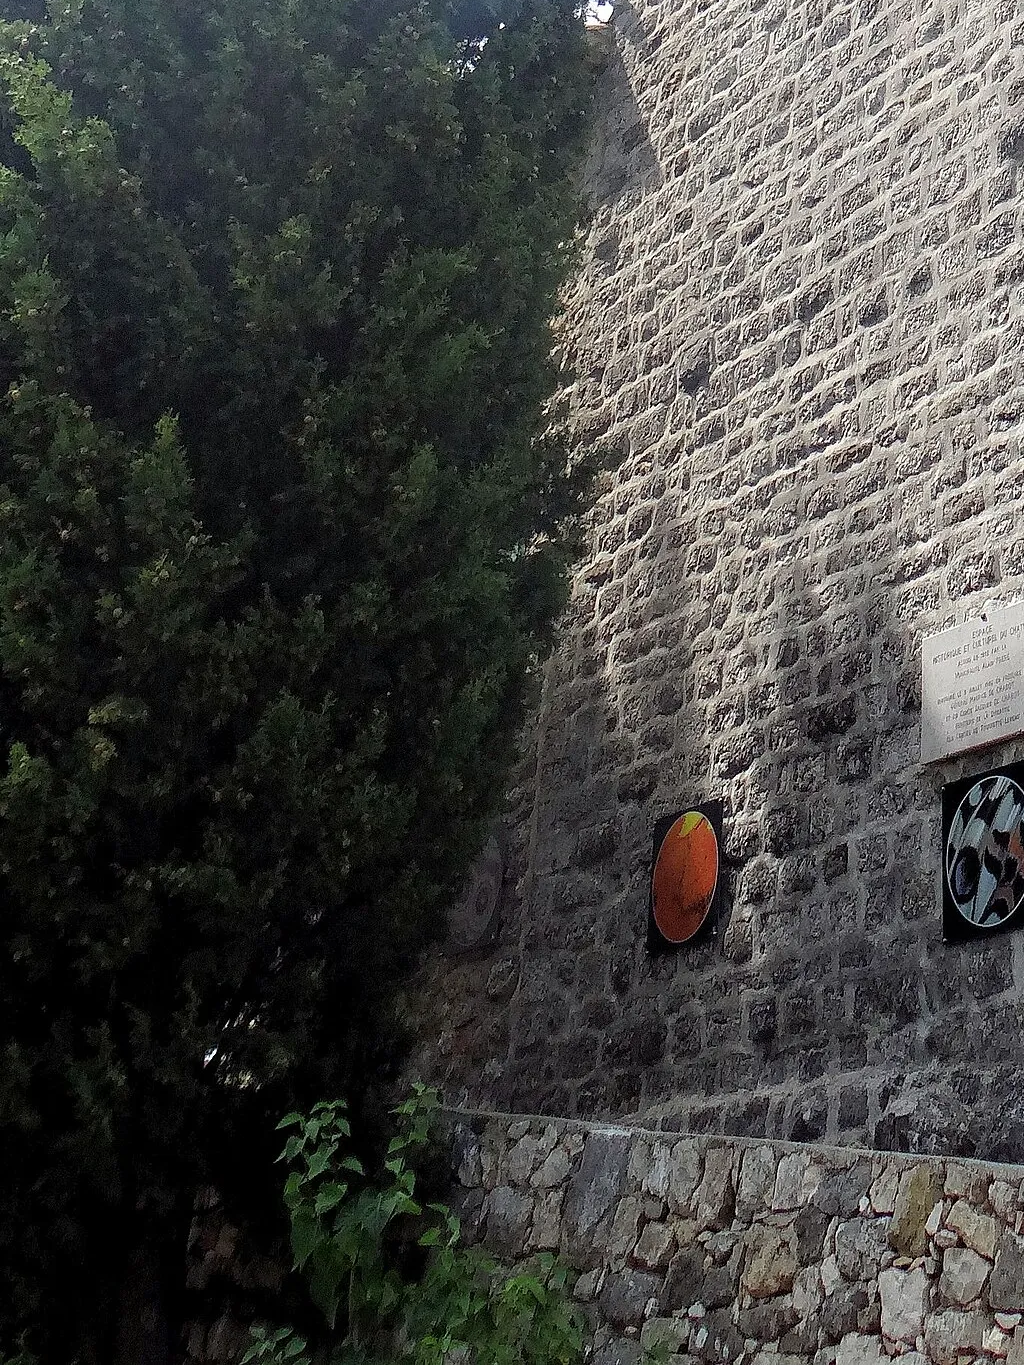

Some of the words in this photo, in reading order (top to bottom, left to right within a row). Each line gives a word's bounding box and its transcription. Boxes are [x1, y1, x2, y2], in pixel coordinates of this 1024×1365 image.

[963, 643, 970, 653] ET
[1000, 629, 1008, 640] DU
[972, 624, 994, 639] ESPACE
